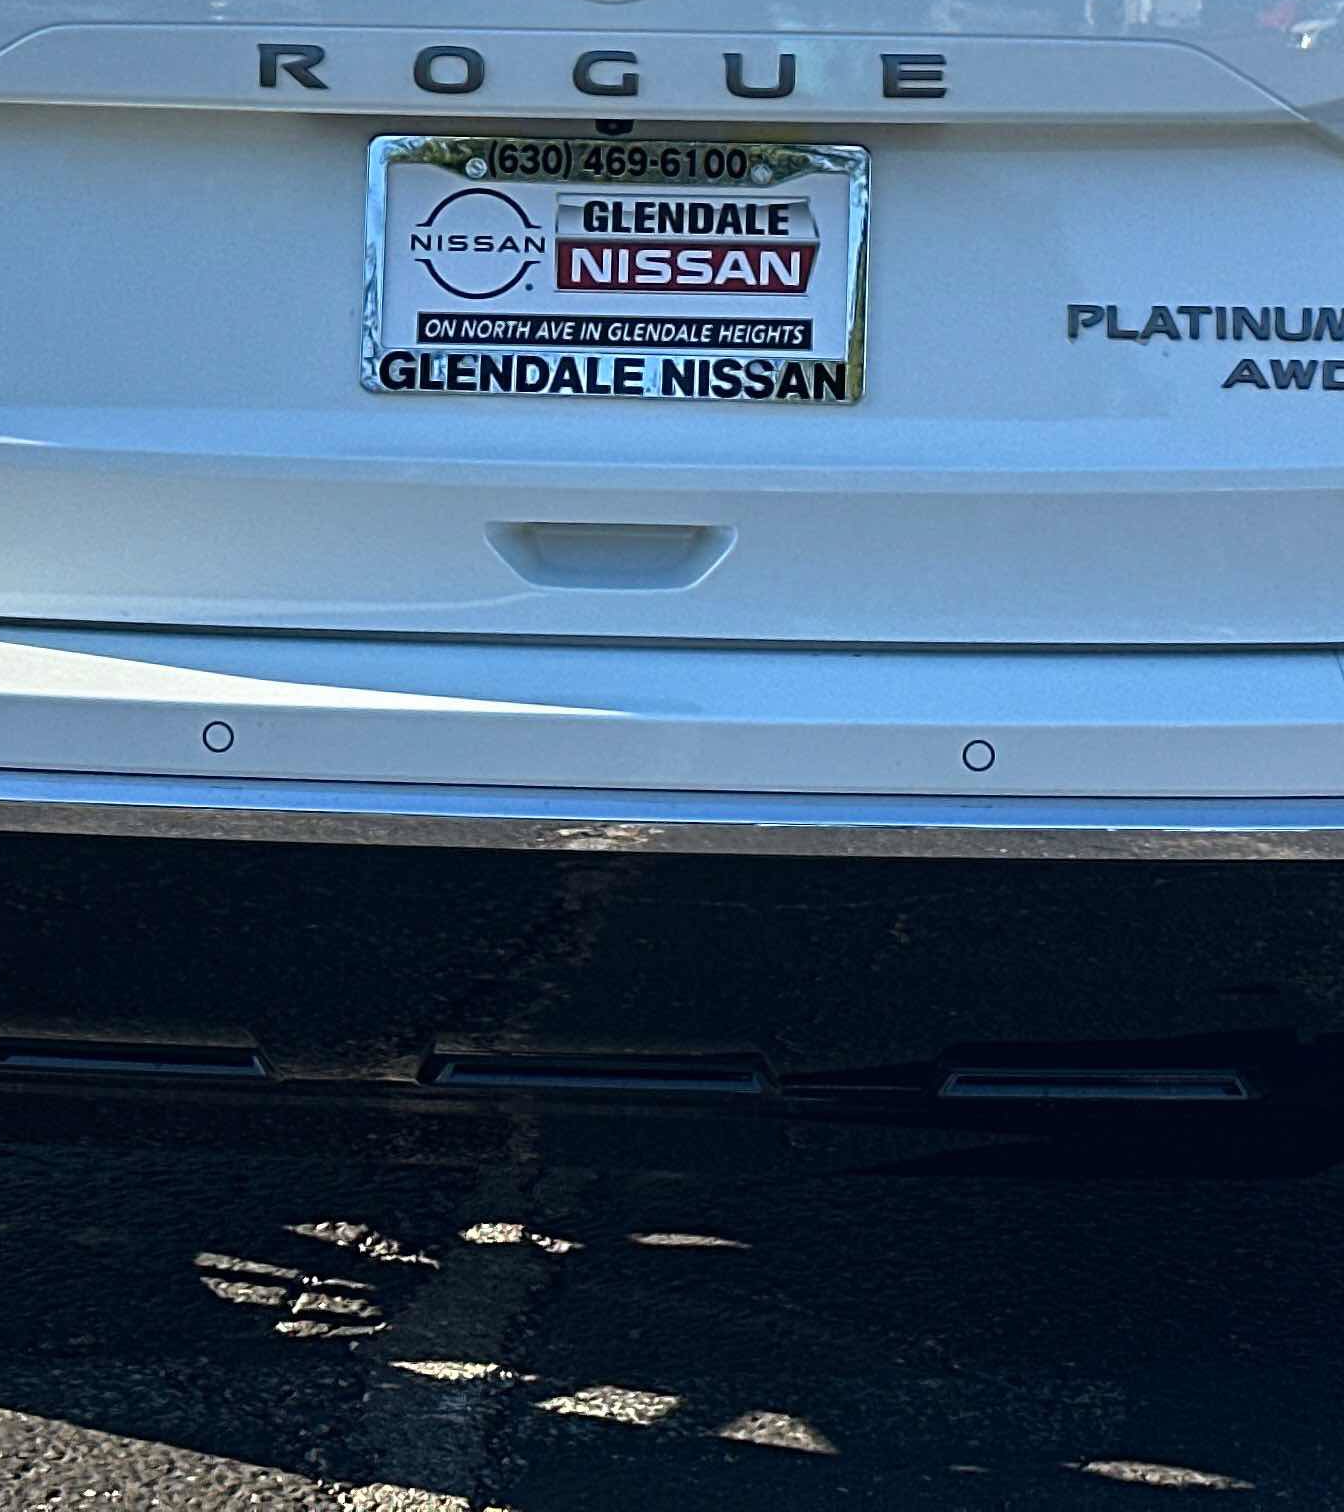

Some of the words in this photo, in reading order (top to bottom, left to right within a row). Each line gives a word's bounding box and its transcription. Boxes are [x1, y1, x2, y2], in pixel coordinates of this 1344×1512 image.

[256, 43, 948, 99] ROGUE
[487, 141, 573, 179] (630)
[583, 147, 749, 181] 469-6100
[582, 199, 791, 237] GLENDALE
[410, 232, 547, 254] NISSAN
[570, 246, 802, 288] NISSAN
[424, 319, 455, 339] ON
[460, 320, 531, 340] NORTH
[535, 322, 576, 341] AVE
[580, 322, 602, 342] IN
[607, 323, 713, 343] GLENDALE
[718, 325, 805, 345] HEIGHTS
[378, 350, 646, 397] GLENDALE
[660, 358, 848, 401] NISSAN
